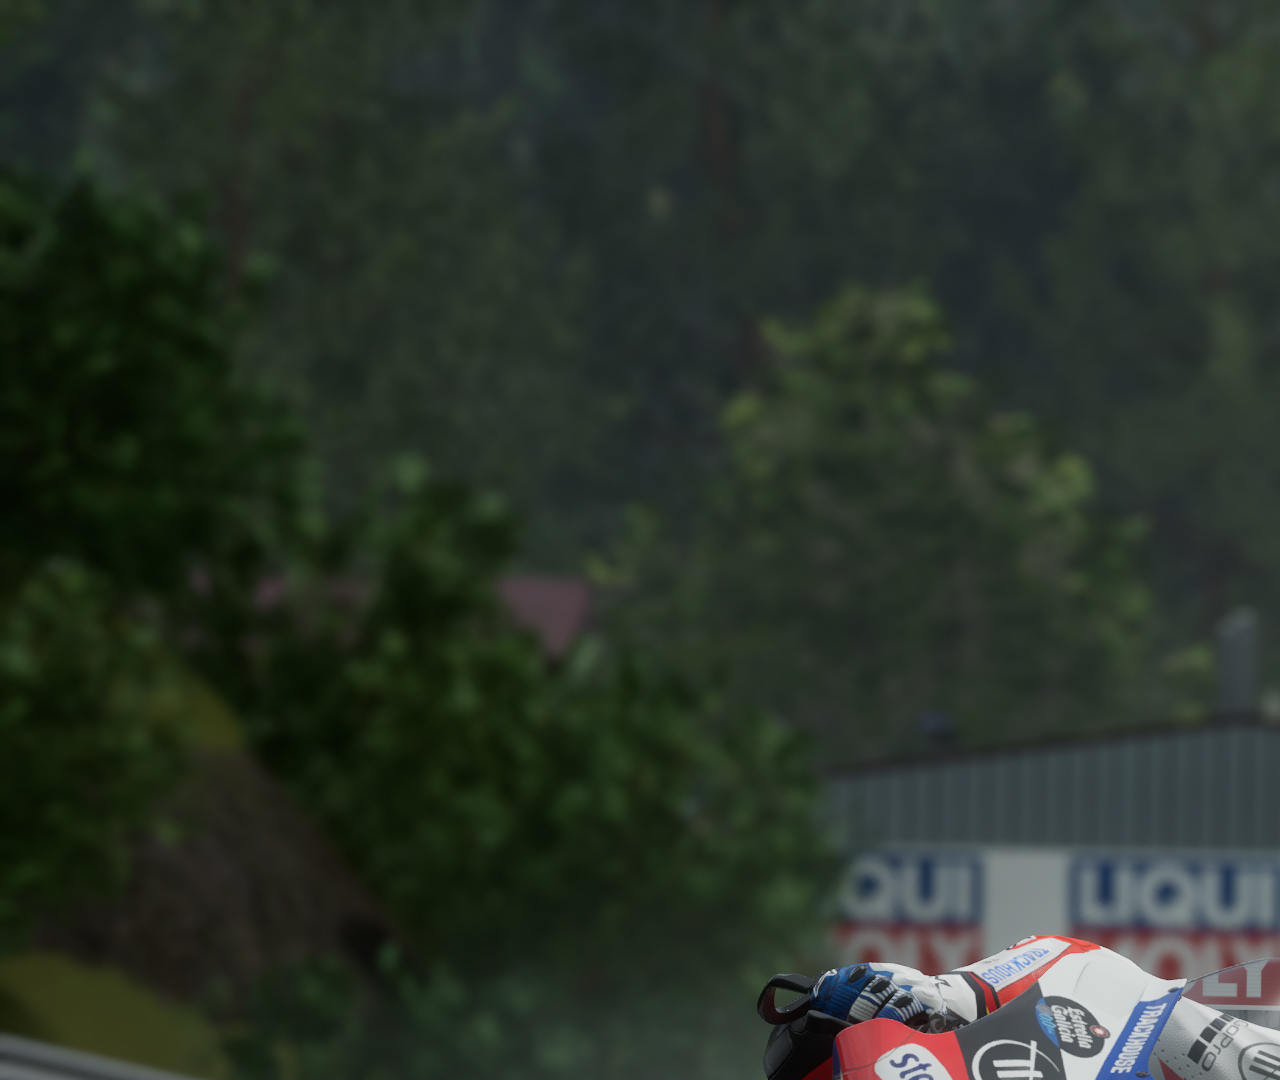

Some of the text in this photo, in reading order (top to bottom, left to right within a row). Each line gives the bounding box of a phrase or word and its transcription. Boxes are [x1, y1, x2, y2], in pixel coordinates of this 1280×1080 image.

[838, 860, 972, 919] QUI
[1080, 870, 1276, 928] LIQUI
[981, 948, 1050, 986] TRACKHOUS
[1051, 1005, 1076, 1043] Galicia
[1067, 1006, 1093, 1049] Estrella
[1110, 1002, 1168, 1075] TRACKHOUSE
